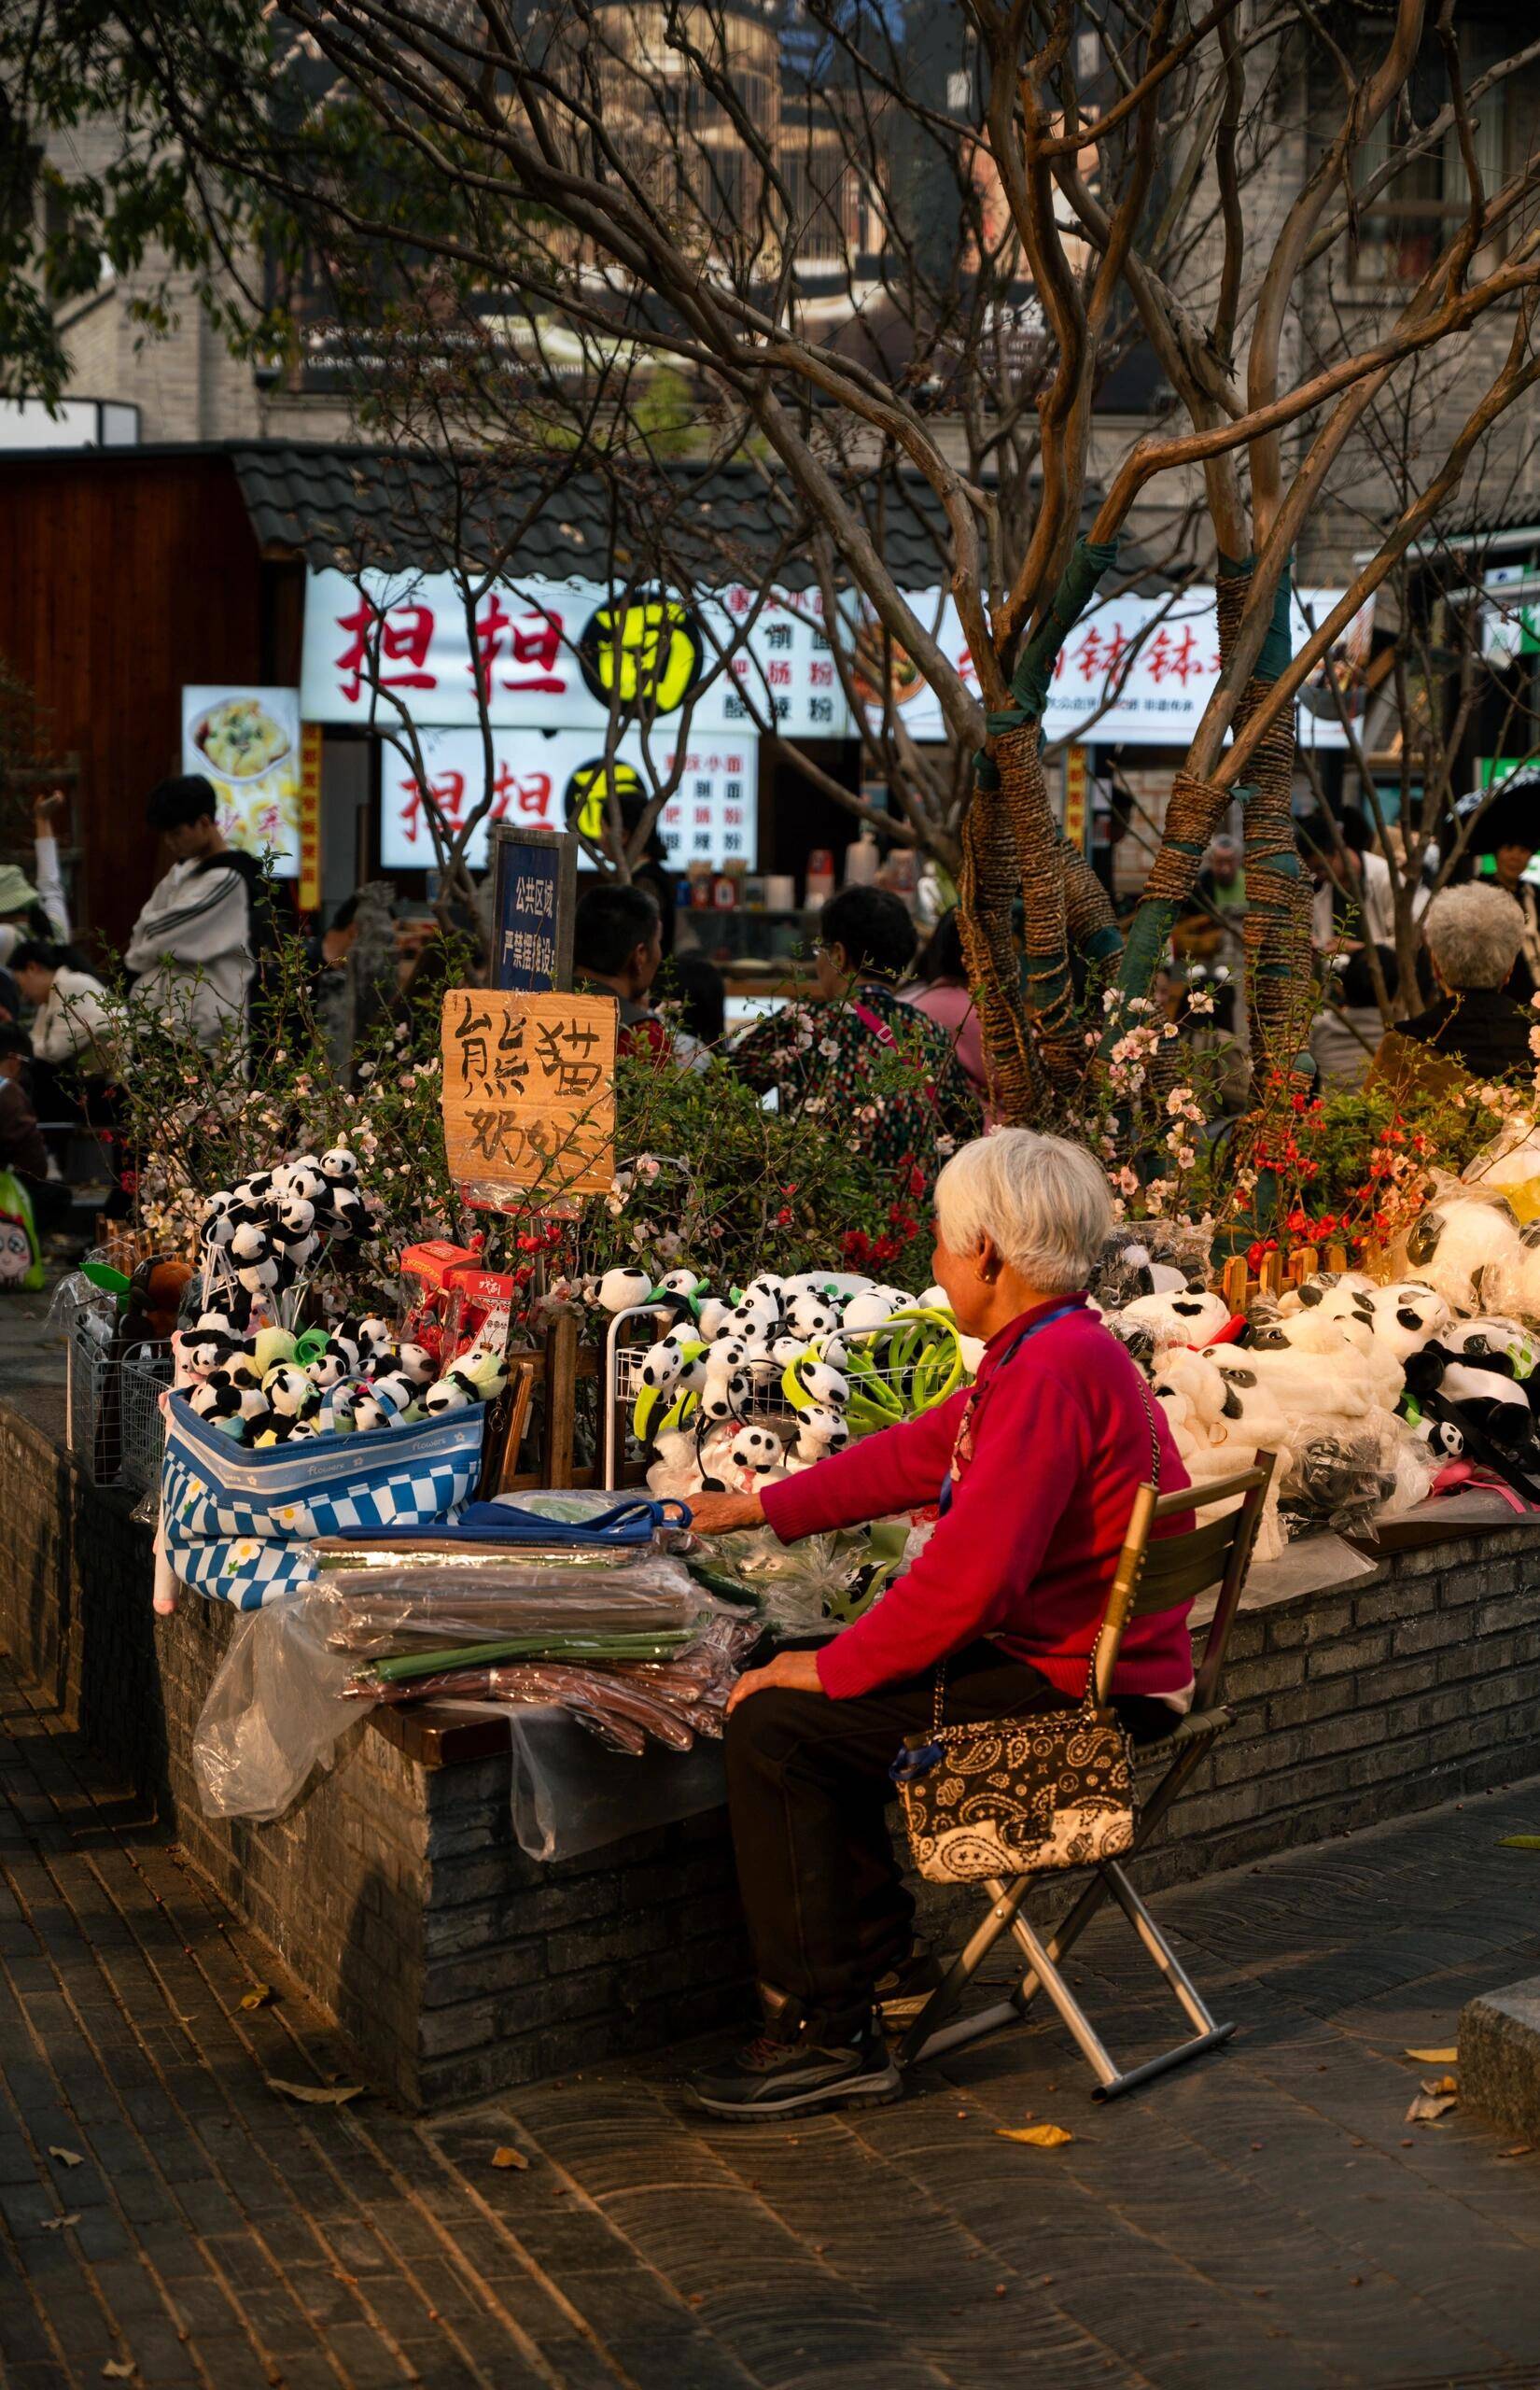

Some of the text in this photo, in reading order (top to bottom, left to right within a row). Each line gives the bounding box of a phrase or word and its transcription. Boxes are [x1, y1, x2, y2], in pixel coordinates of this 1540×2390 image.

[515, 876, 554, 919] 公共区域
[502, 930, 555, 976] 严禁摆摊设
[455, 996, 602, 1100] 熊猫
[306, 1463, 344, 1476] flowers
